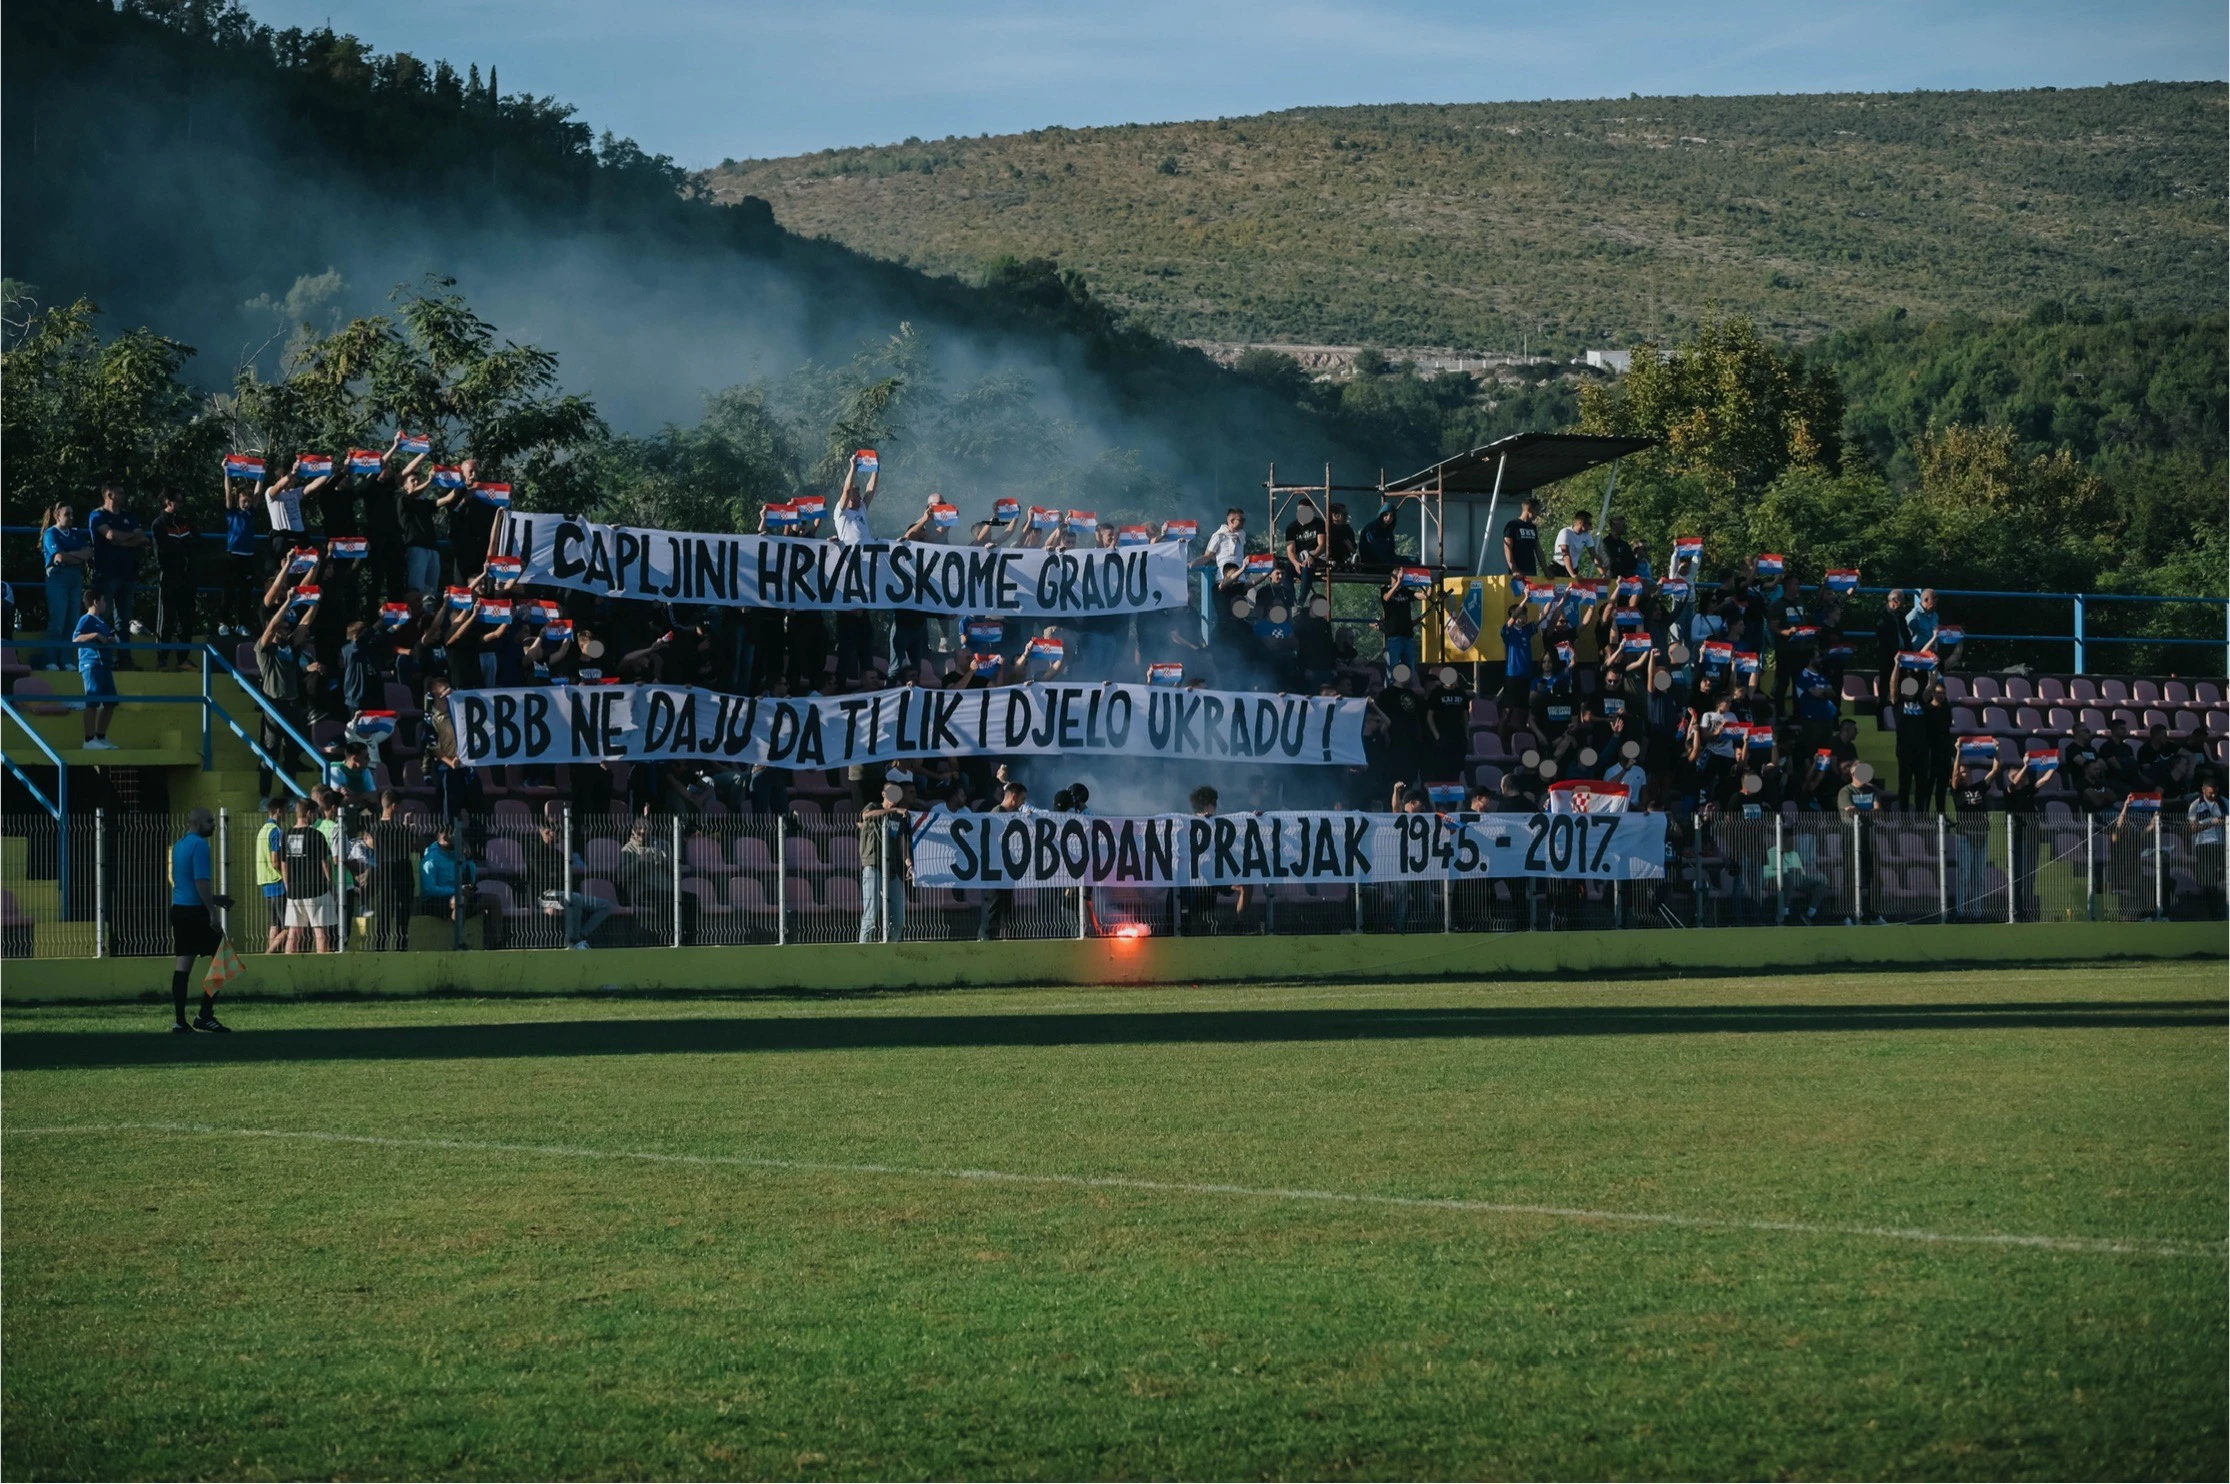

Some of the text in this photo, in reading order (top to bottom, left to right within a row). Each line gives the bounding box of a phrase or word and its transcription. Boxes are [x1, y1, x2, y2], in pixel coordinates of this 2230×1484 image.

[757, 543, 1023, 609] HRVATSKOME
[1037, 551, 1162, 611] GRADU,
[464, 688, 1335, 765] BBB NE DAJU DA TI LIK I DJELO UKRADU !
[949, 813, 1622, 882] SLOBODAN PRALJAK 1945. - 2017.
